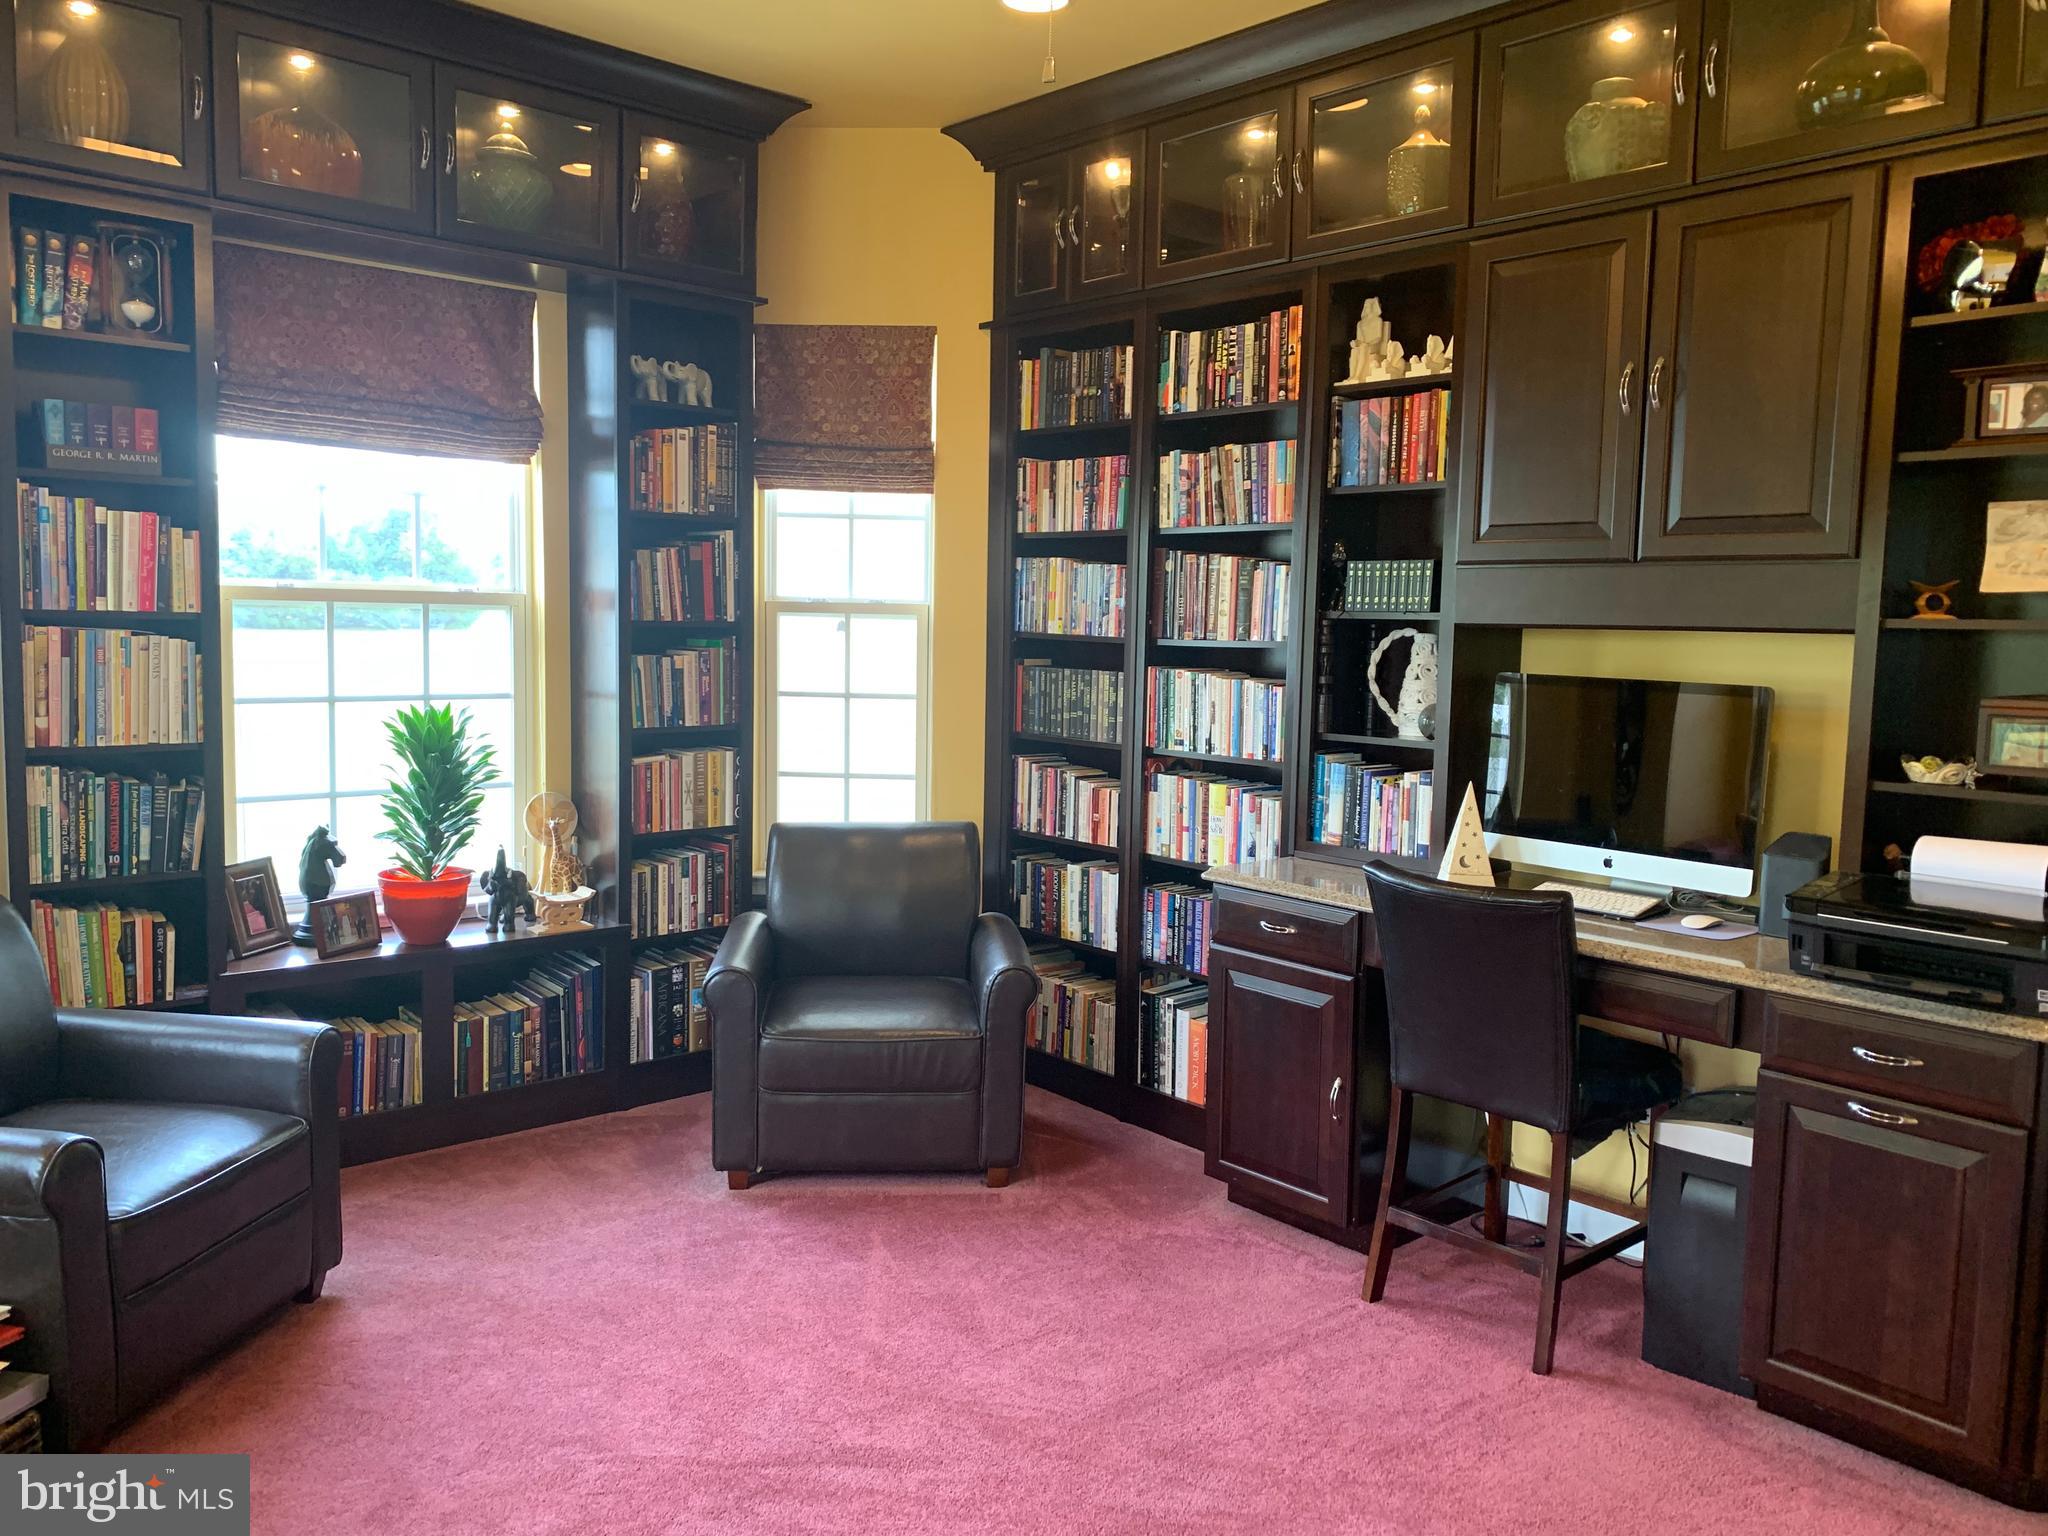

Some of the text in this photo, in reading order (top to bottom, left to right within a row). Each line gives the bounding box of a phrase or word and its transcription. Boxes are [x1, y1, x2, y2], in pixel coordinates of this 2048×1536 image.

[25, 264, 36, 284] LOST
[78, 279, 90, 305] MARK
[26, 284, 36, 307] HERO
[52, 448, 94, 460] GEORGE
[95, 451, 105, 460] R.
[119, 453, 158, 464] MARTIN
[151, 642, 161, 680] ROOMS
[96, 687, 105, 729] TRIMWORK
[109, 780, 120, 852] JAMES PATTERSON
[61, 819, 70, 855] Terra Cotta
[78, 922, 92, 991] HOME DECORATING
[156, 927, 164, 953] GREY
[656, 982, 669, 1037] AFRICANA
[511, 1031, 524, 1075] Freemasonry
[1191, 1036, 1201, 1090] MOBY DICK
